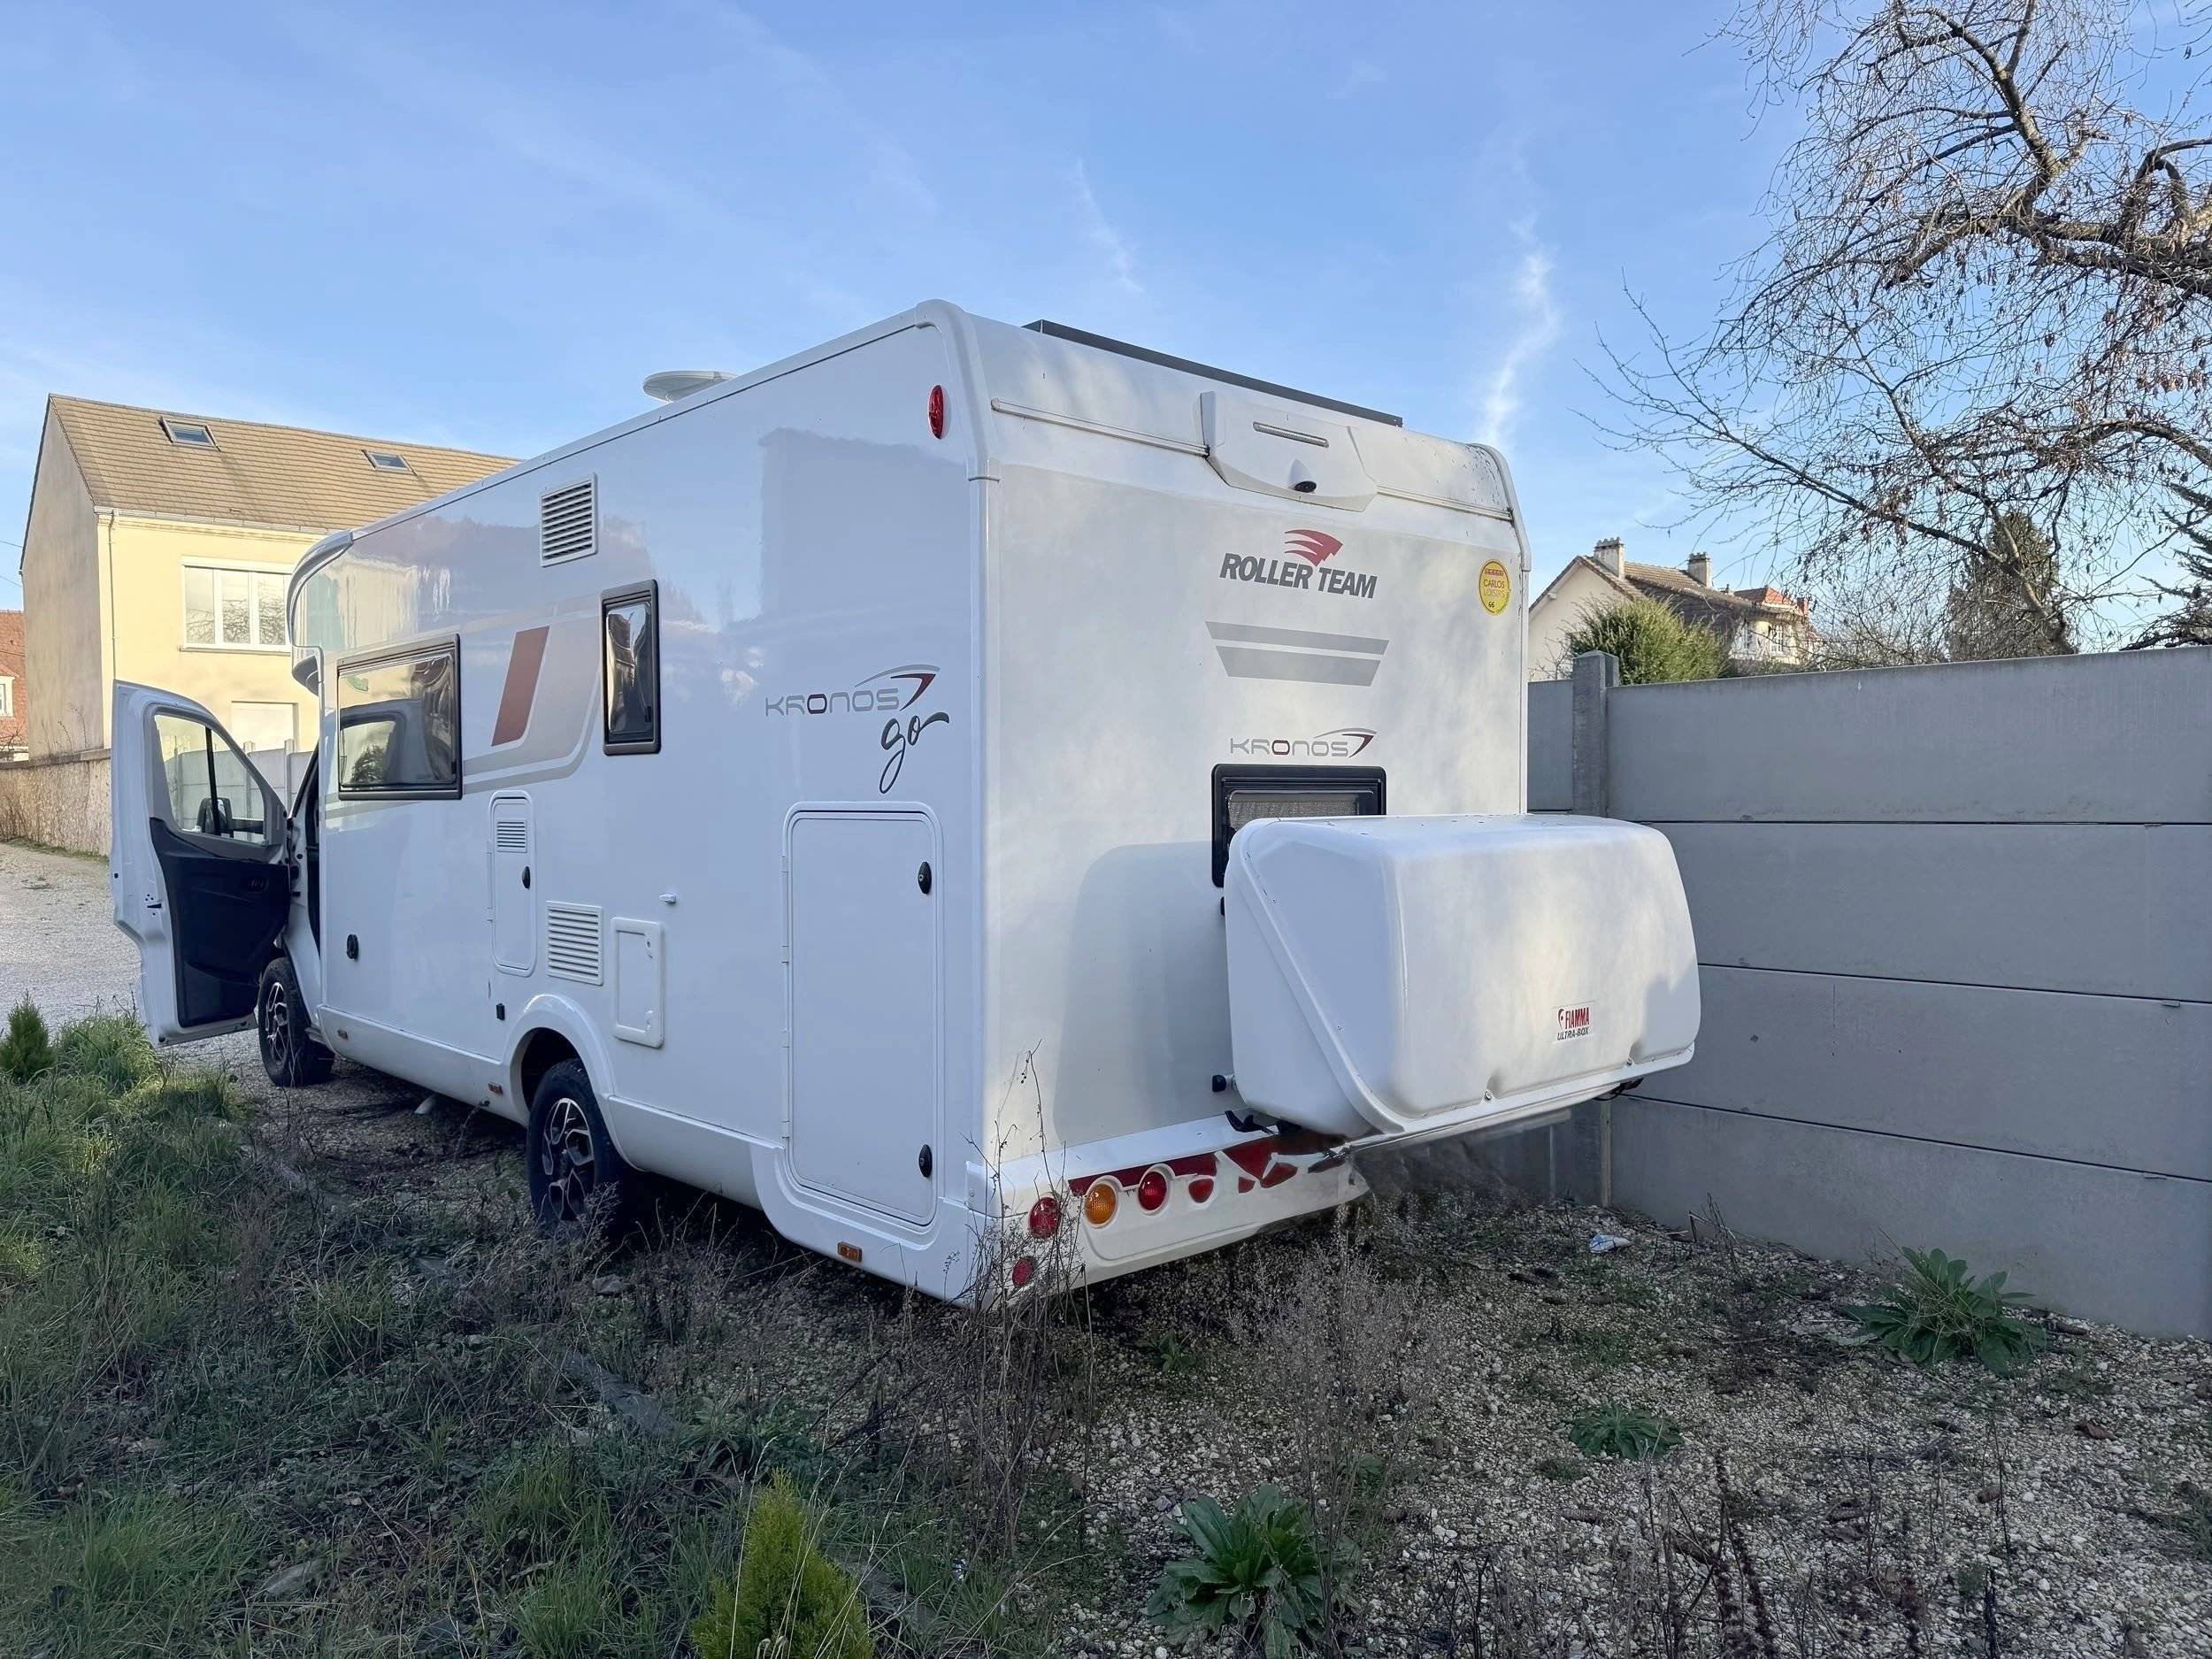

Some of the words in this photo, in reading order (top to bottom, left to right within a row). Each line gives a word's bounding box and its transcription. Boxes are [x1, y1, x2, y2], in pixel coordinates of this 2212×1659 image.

[1219, 552, 1313, 589] ROLLER
[1317, 567, 1378, 599] TEAM
[1483, 580, 1505, 588] CARLOS
[879, 711, 949, 794] go
[1565, 1007, 1590, 1029] FIAMMA
[1557, 1026, 1589, 1041] ULTRA-BOX
